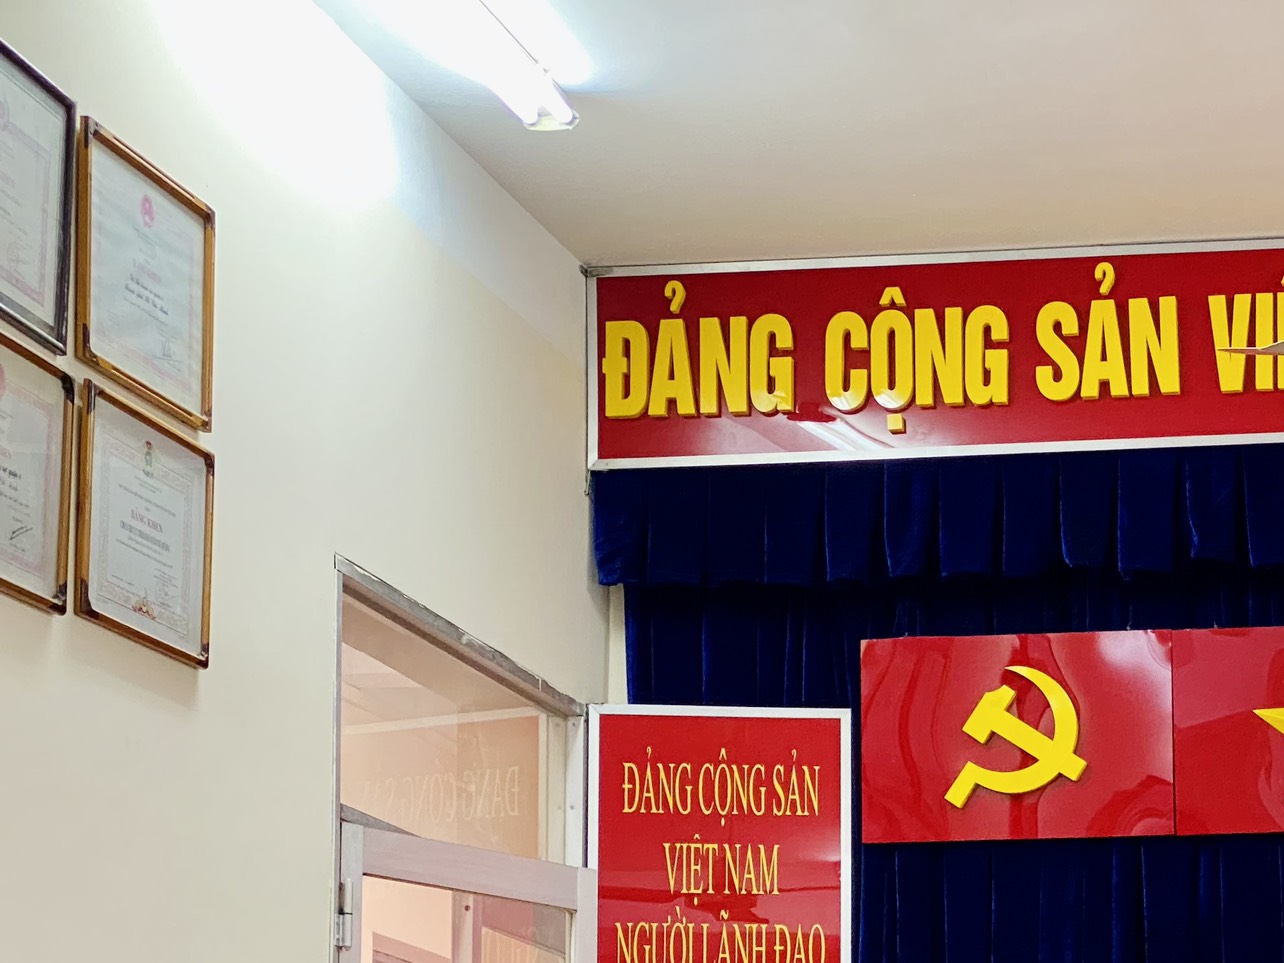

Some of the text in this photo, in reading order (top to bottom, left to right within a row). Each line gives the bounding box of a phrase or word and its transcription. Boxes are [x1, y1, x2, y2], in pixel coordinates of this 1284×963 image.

[602, 280, 797, 419] ĐẢNG
[825, 287, 1010, 434] CỘNG
[1036, 262, 1181, 402] SẢN
[622, 746, 820, 826] ĐẢNG CỘNG SẢN
[663, 834, 780, 905] VIỆT NAM
